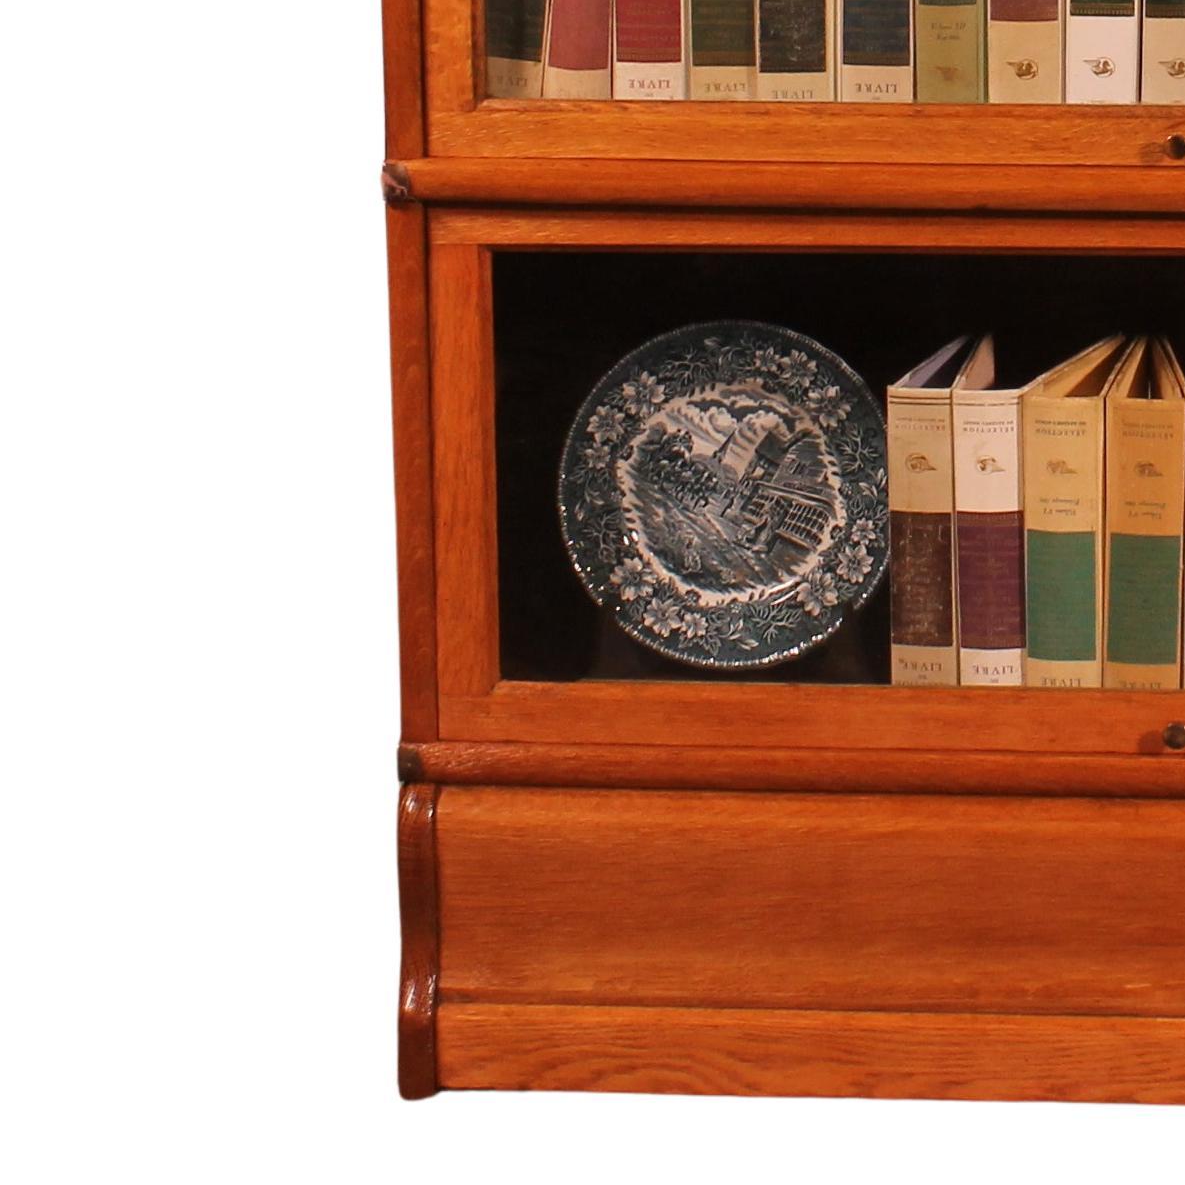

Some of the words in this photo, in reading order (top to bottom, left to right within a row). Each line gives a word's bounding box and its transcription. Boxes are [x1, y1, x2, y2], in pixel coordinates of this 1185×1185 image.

[628, 79, 670, 90] LIVRE
[704, 82, 746, 93] LIVRE
[855, 82, 898, 94] LIVRE
[771, 89, 814, 99] LIVRE
[901, 662, 943, 673] LIVRE
[972, 664, 1014, 676] LIVRE
[1040, 677, 1081, 687] LIVRE
